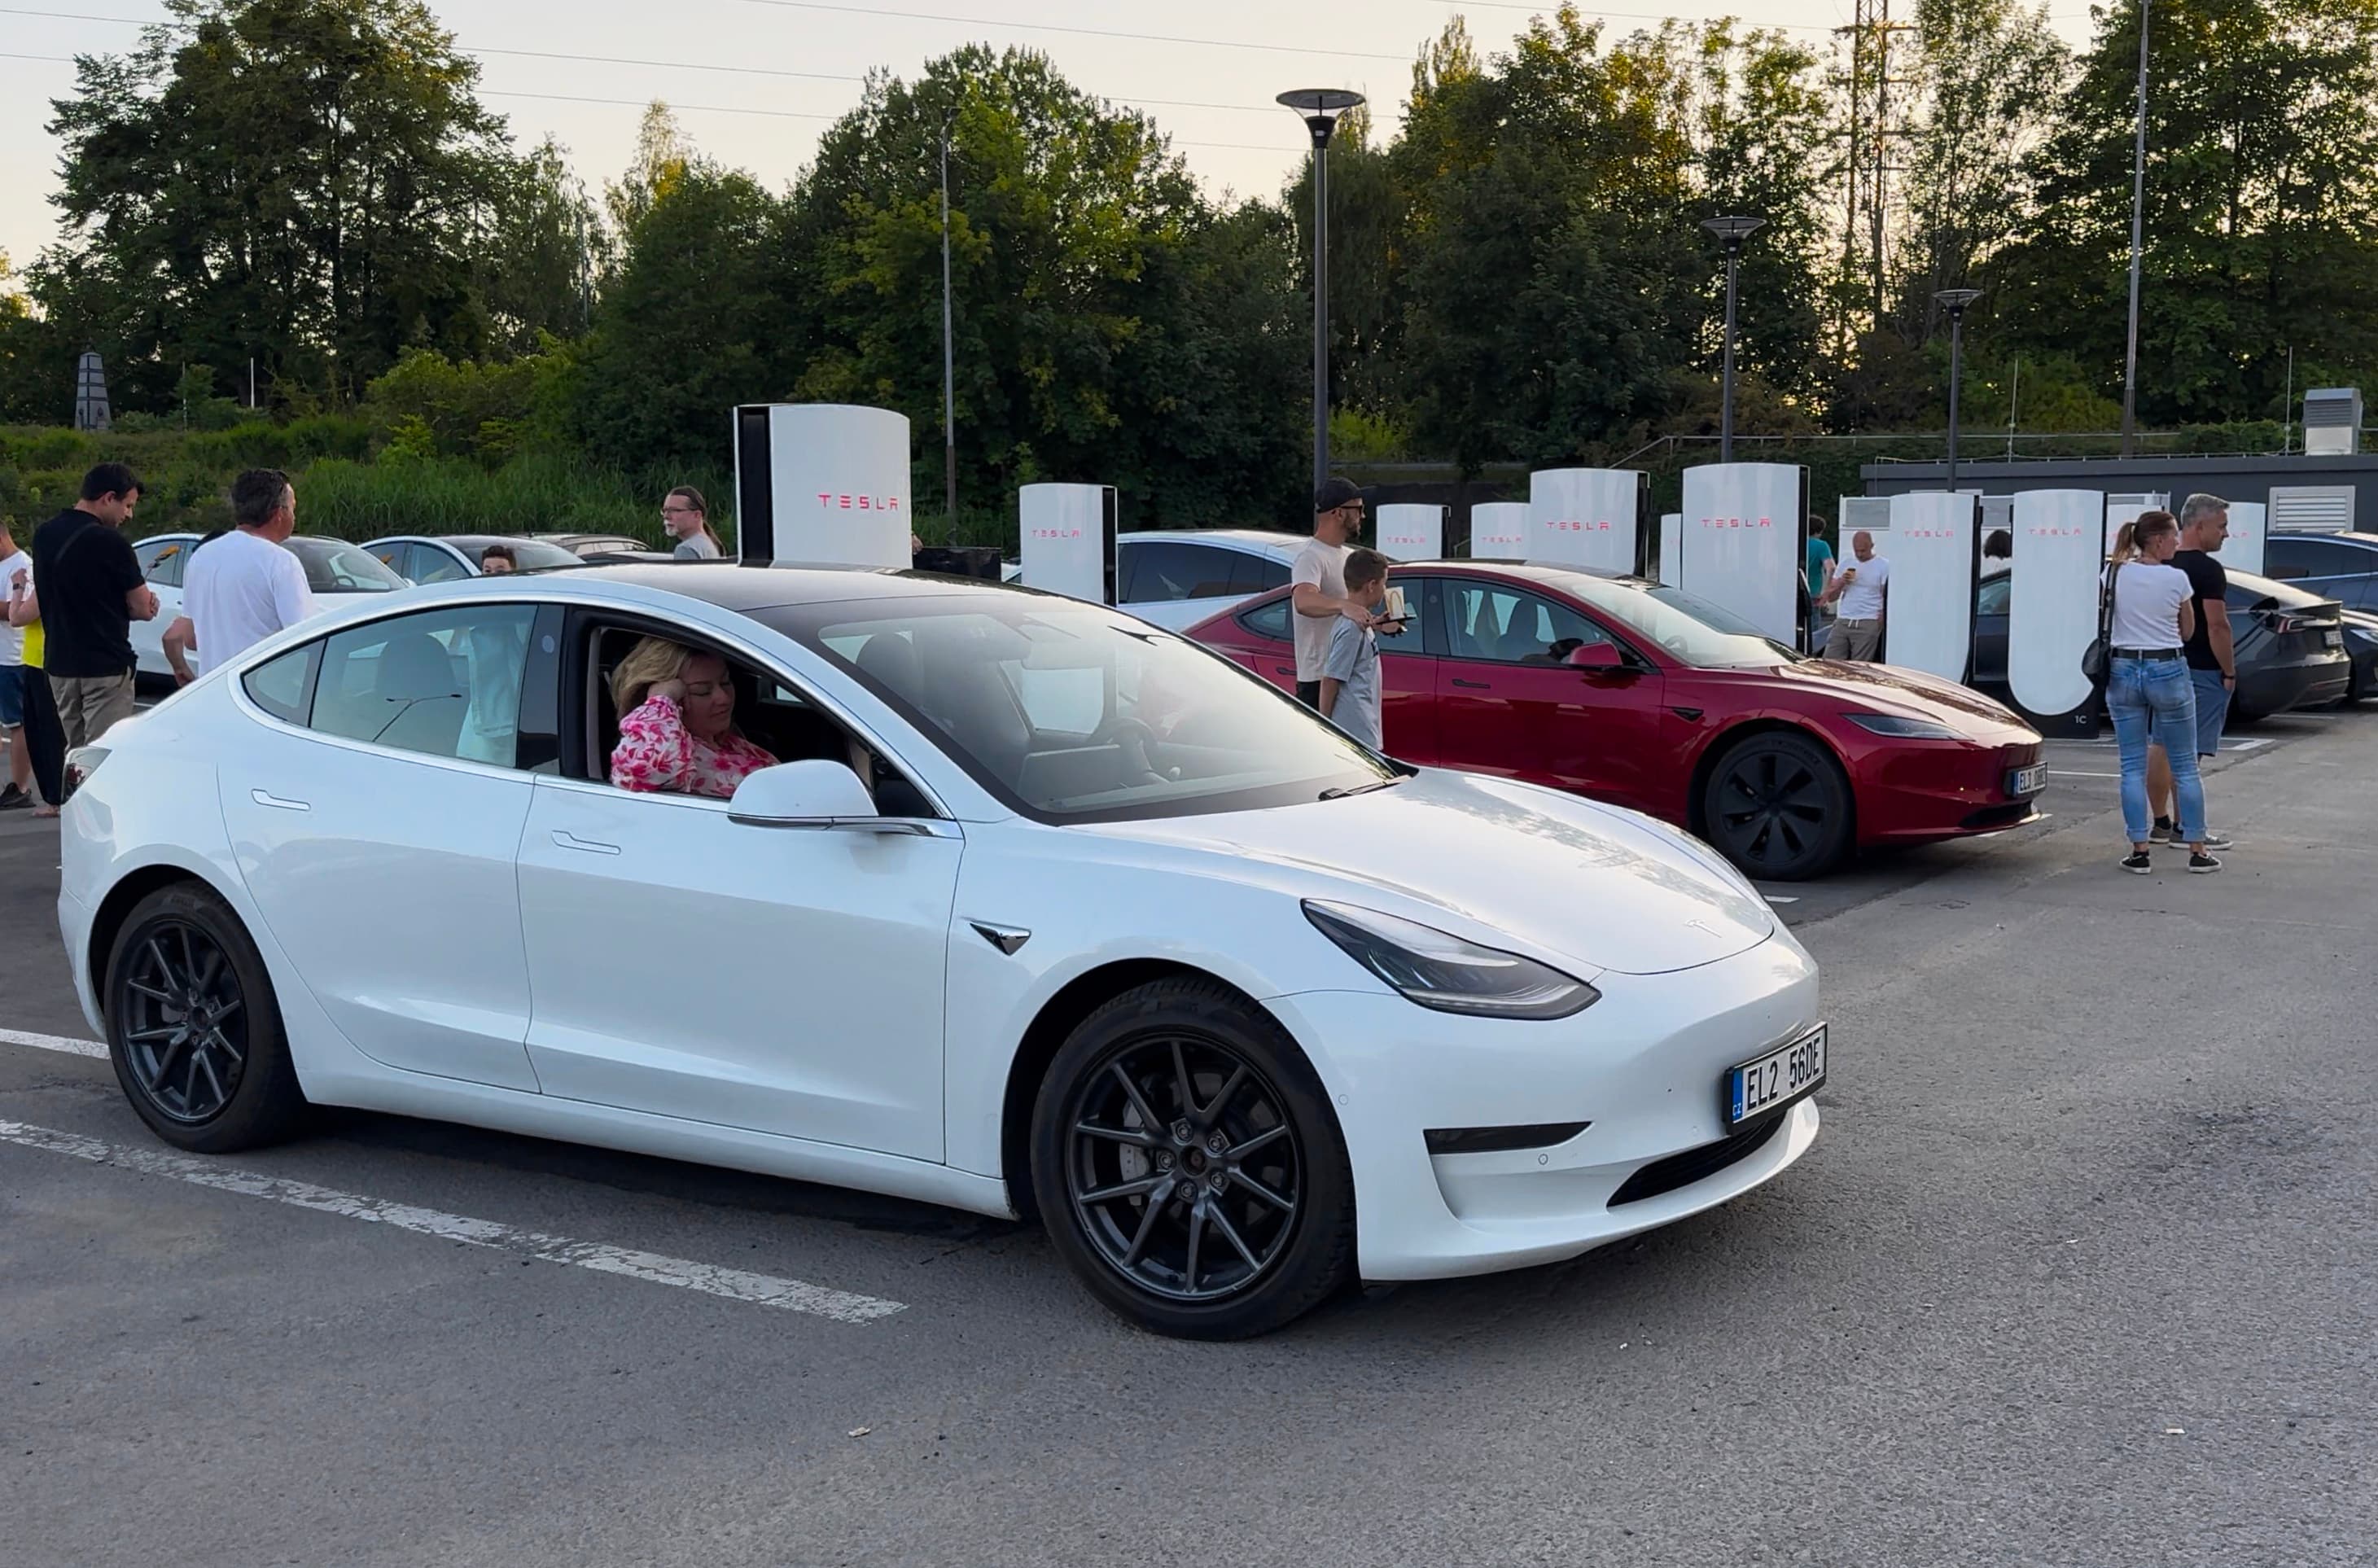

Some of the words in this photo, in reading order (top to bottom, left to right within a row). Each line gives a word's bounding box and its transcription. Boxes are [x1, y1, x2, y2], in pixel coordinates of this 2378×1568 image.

[817, 494, 899, 510] TESLA
[1547, 521, 1609, 531] TESLA
[1701, 518, 1771, 528] TESLA
[1031, 528, 1080, 538] TESLA
[1904, 530, 1954, 538] TESLA
[2028, 528, 2082, 536] TESLA
[2075, 715, 2087, 725] 1C
[1746, 1060, 1778, 1111] EL2
[1789, 1036, 1820, 1089] 56DE
[1732, 1102, 1741, 1116] CZ
